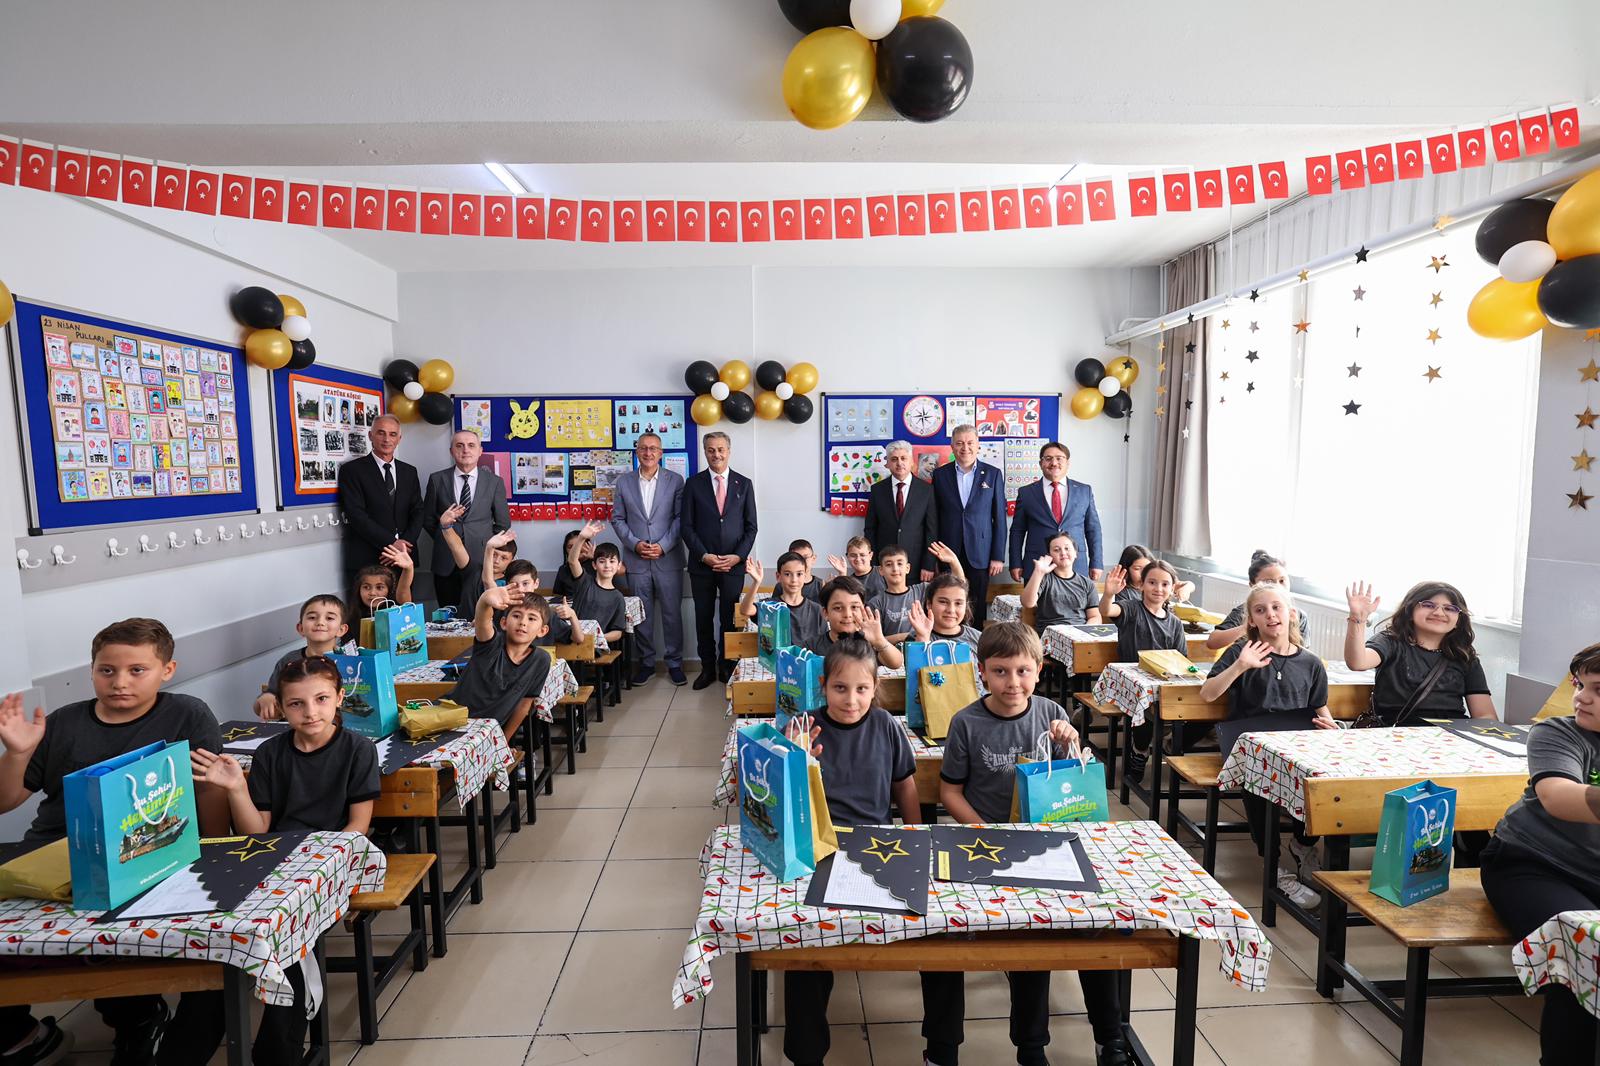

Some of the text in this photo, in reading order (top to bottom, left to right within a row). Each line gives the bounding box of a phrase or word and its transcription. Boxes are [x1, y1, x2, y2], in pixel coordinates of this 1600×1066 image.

[43, 318, 52, 327] 23
[75, 332, 105, 343] PULLARI
[323, 388, 346, 398] ATATÜRK
